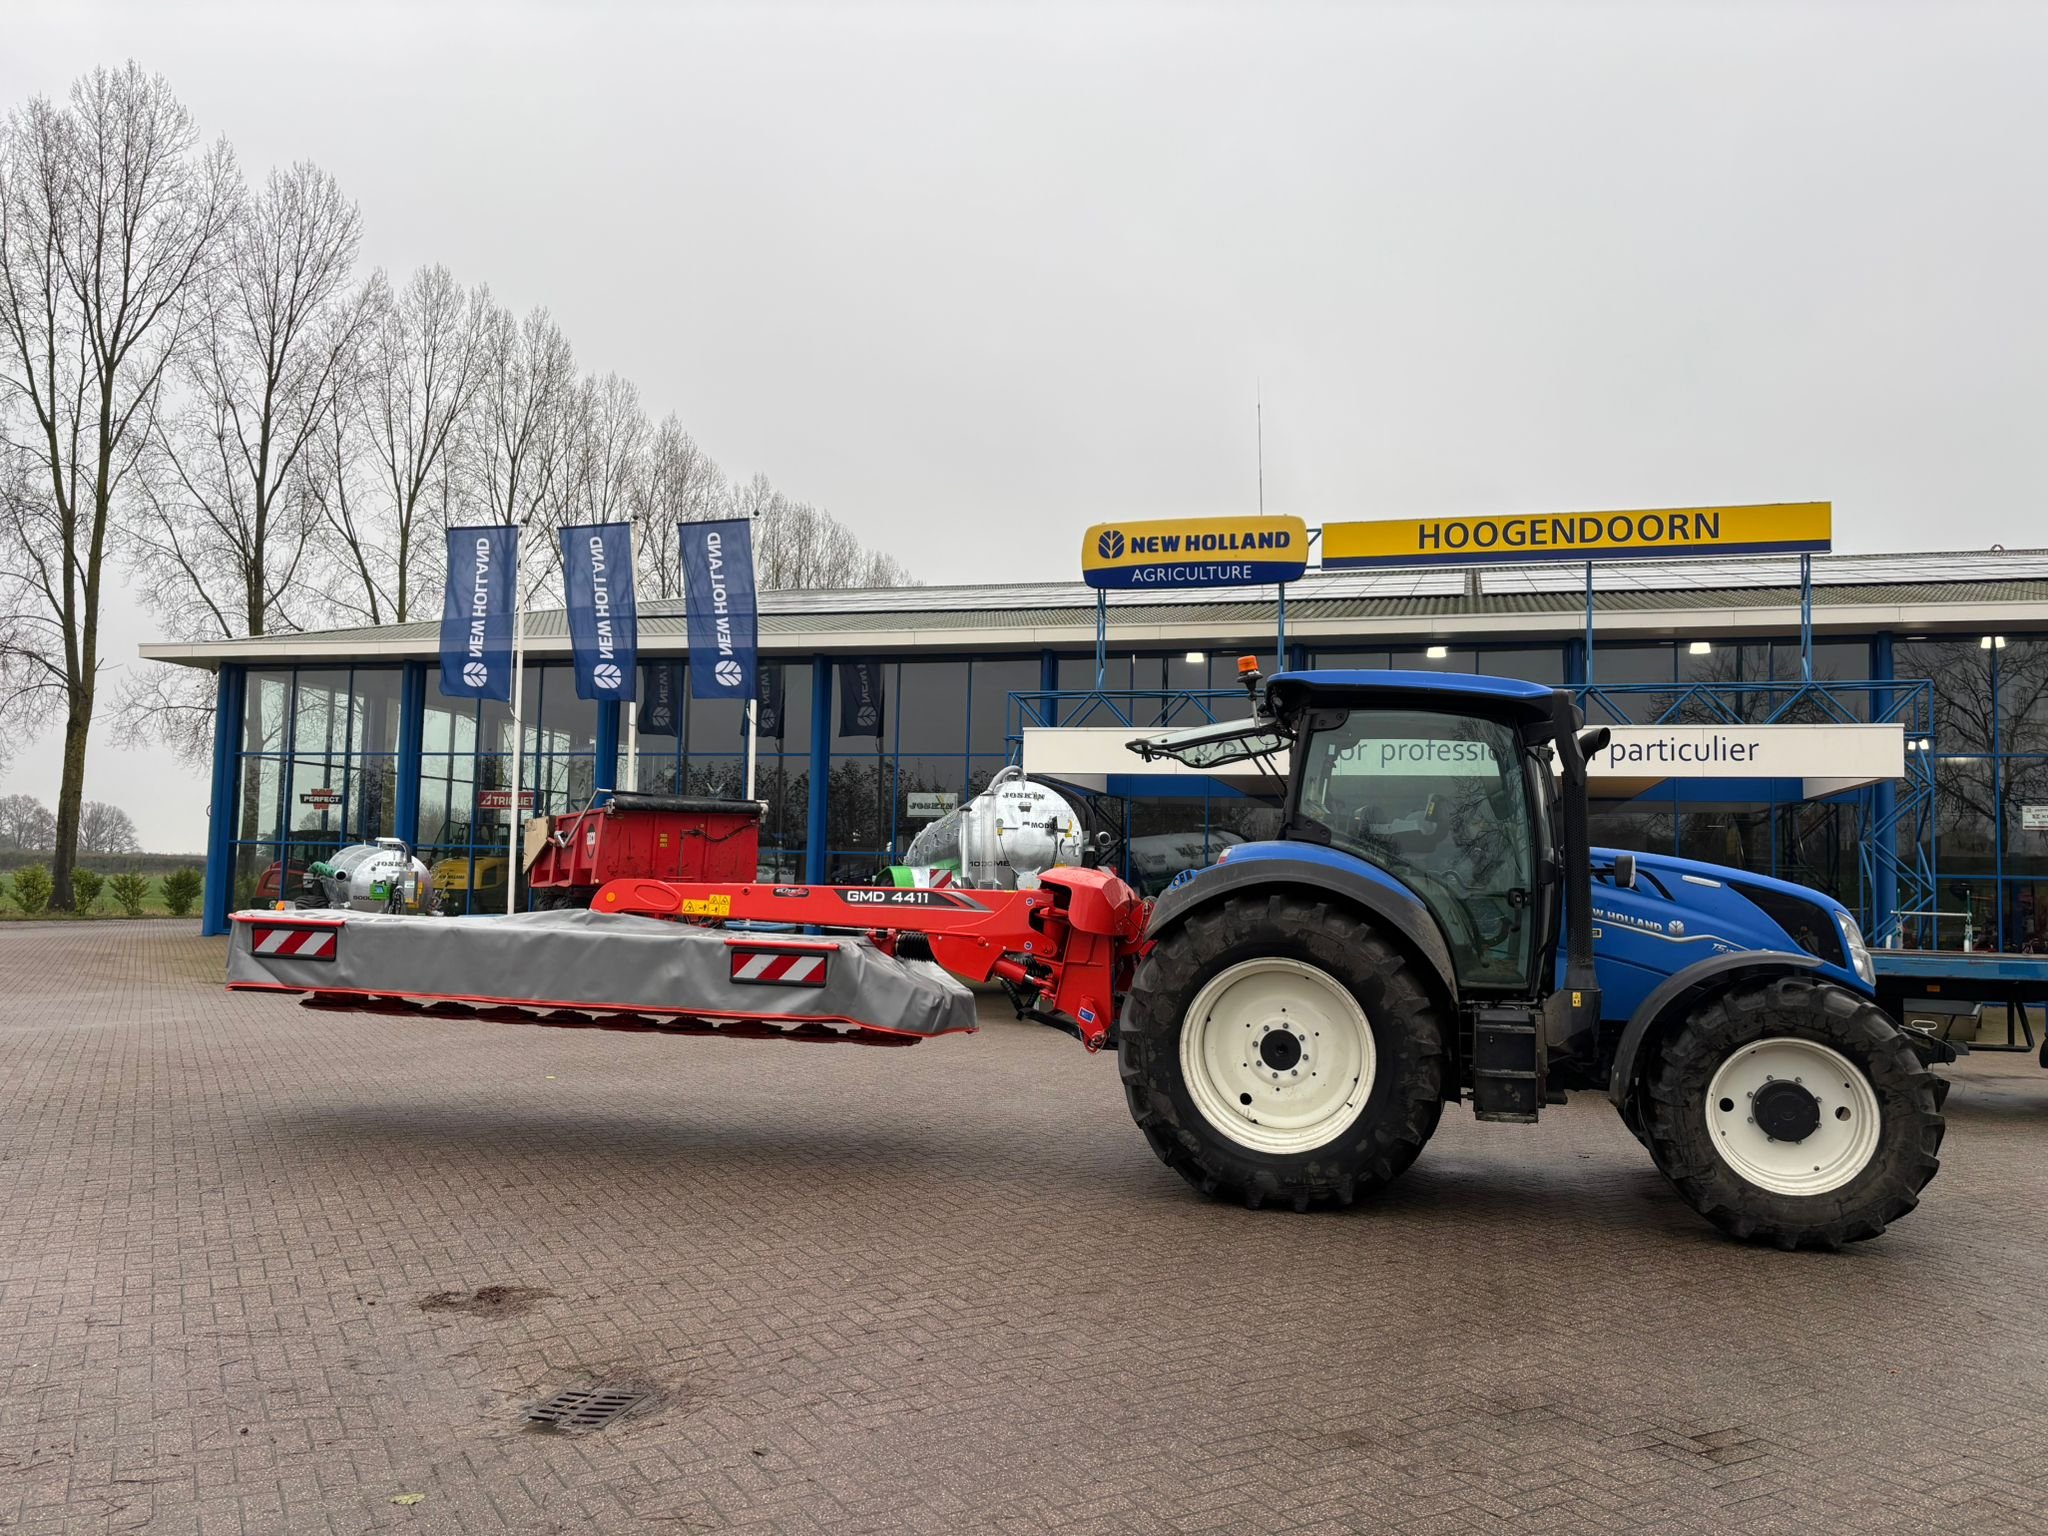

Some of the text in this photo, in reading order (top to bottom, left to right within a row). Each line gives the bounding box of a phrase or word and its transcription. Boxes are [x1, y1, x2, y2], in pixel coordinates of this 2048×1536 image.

[1418, 512, 1719, 549] HOOGENDOORN
[1131, 531, 1290, 553] NEW HOLLAND
[1131, 565, 1252, 582] AGRICULTURE
[1340, 742, 1367, 761] or
[1610, 735, 1759, 769] particulier
[493, 796, 535, 806] TRIIET
[1002, 792, 1046, 800] JOSKIN
[909, 802, 954, 810] JOSKIN
[847, 890, 929, 904] GMD 4411
[1607, 911, 1663, 932] HOLLAND
